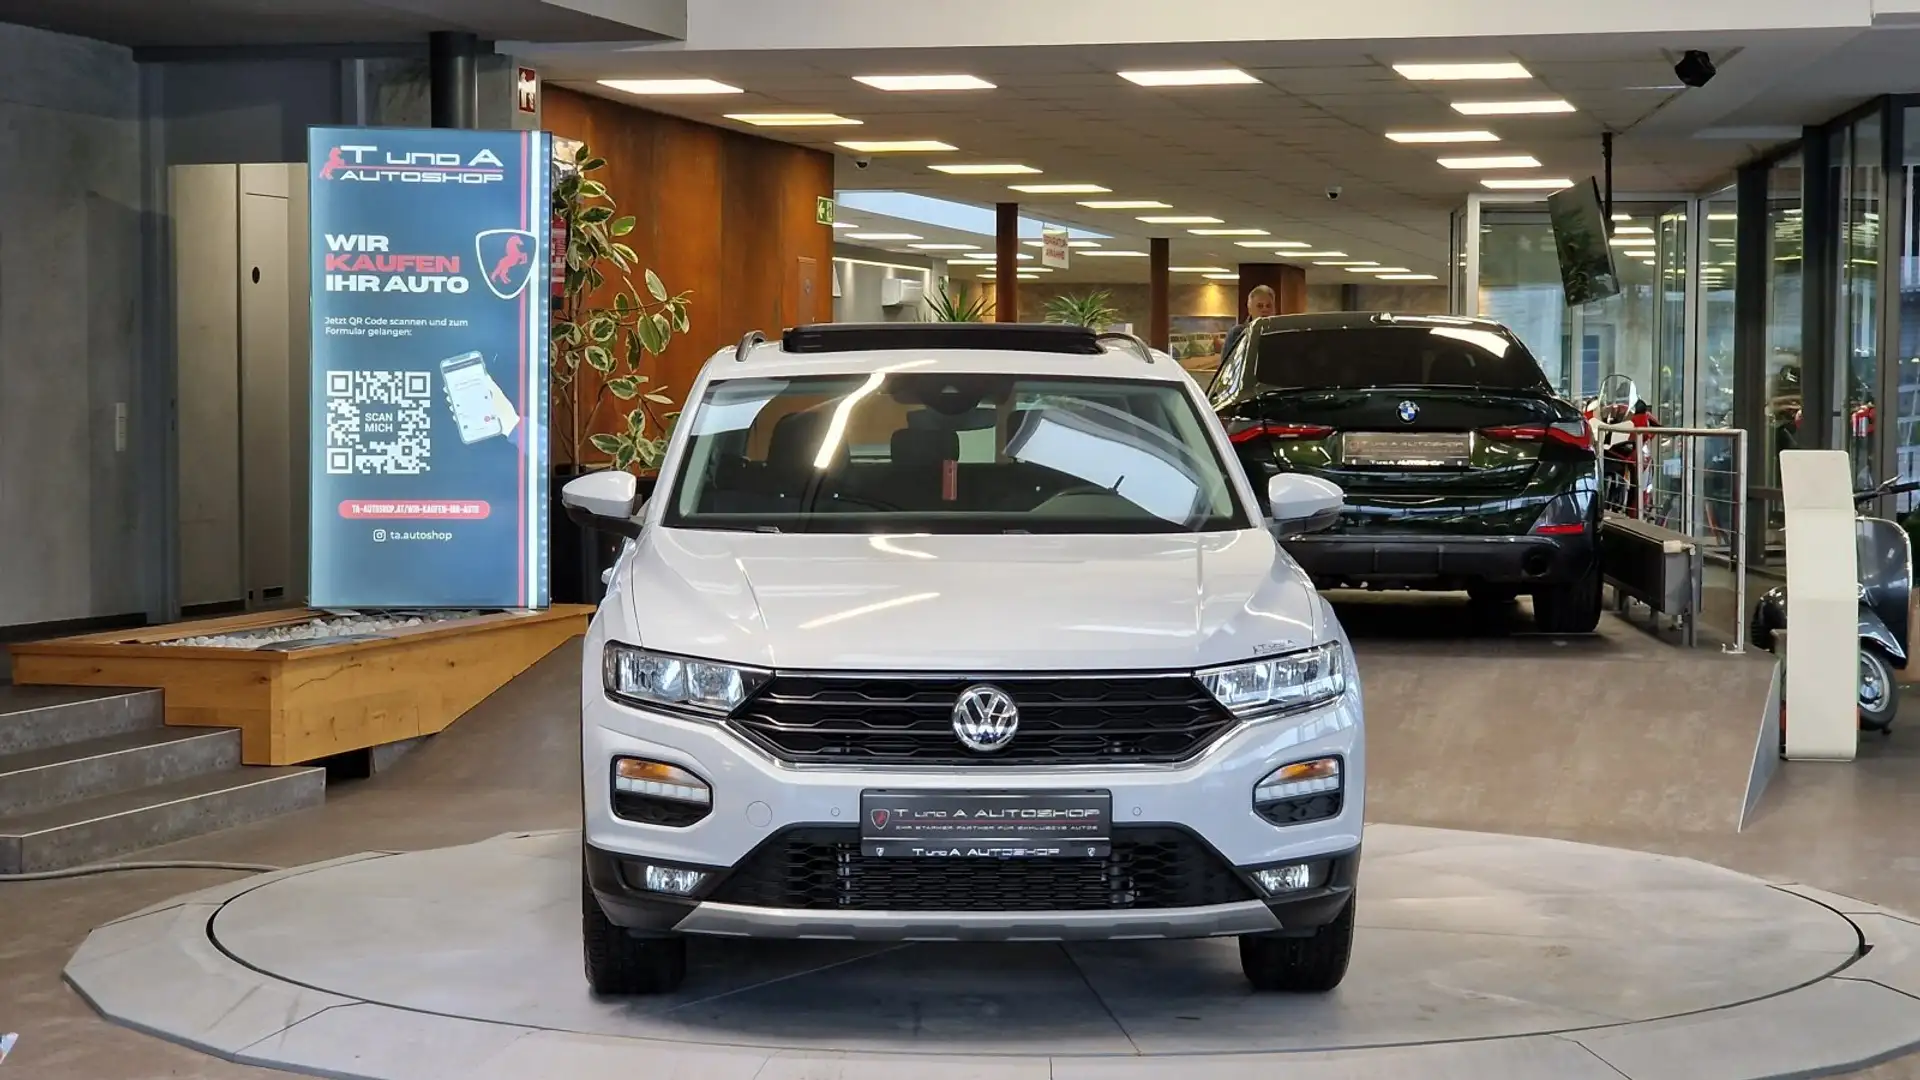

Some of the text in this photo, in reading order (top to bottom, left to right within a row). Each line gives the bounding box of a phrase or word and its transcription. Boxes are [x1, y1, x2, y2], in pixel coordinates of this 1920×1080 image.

[340, 145, 378, 164] T
[468, 148, 504, 167] A
[340, 170, 504, 184] AUTOSHOP
[324, 234, 389, 252] WIR
[325, 254, 460, 273] KAUFEN
[325, 274, 469, 294] IHR AUTO
[324, 316, 469, 327] Jetzt QR Code scannen und zum
[325, 326, 412, 338] Formular gelangen:
[365, 412, 393, 422] SCAN
[364, 423, 393, 433] MICH
[390, 529, 453, 542] ta.autoshop
[893, 808, 909, 818] T
[952, 809, 968, 818] A
[974, 808, 1101, 818] AUTOSHOP
[912, 848, 925, 856] T
[947, 848, 960, 856] A
[967, 848, 1061, 857] AUTOSHOP
